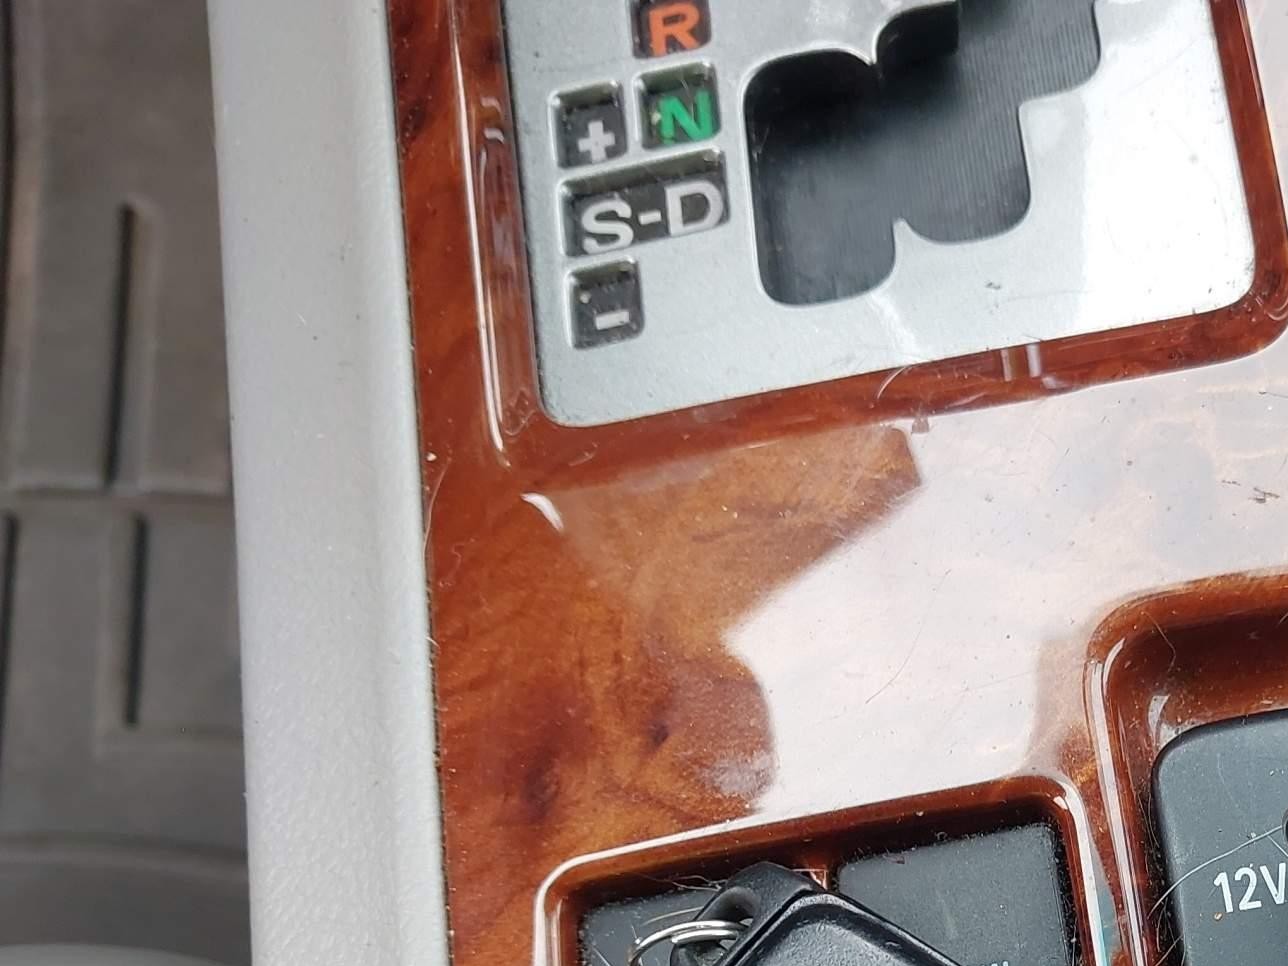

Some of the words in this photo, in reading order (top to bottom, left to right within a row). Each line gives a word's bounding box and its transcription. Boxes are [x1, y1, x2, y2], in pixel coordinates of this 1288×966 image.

[648, 3, 701, 56] R
[660, 89, 713, 145] N
[581, 179, 724, 254] S-D
